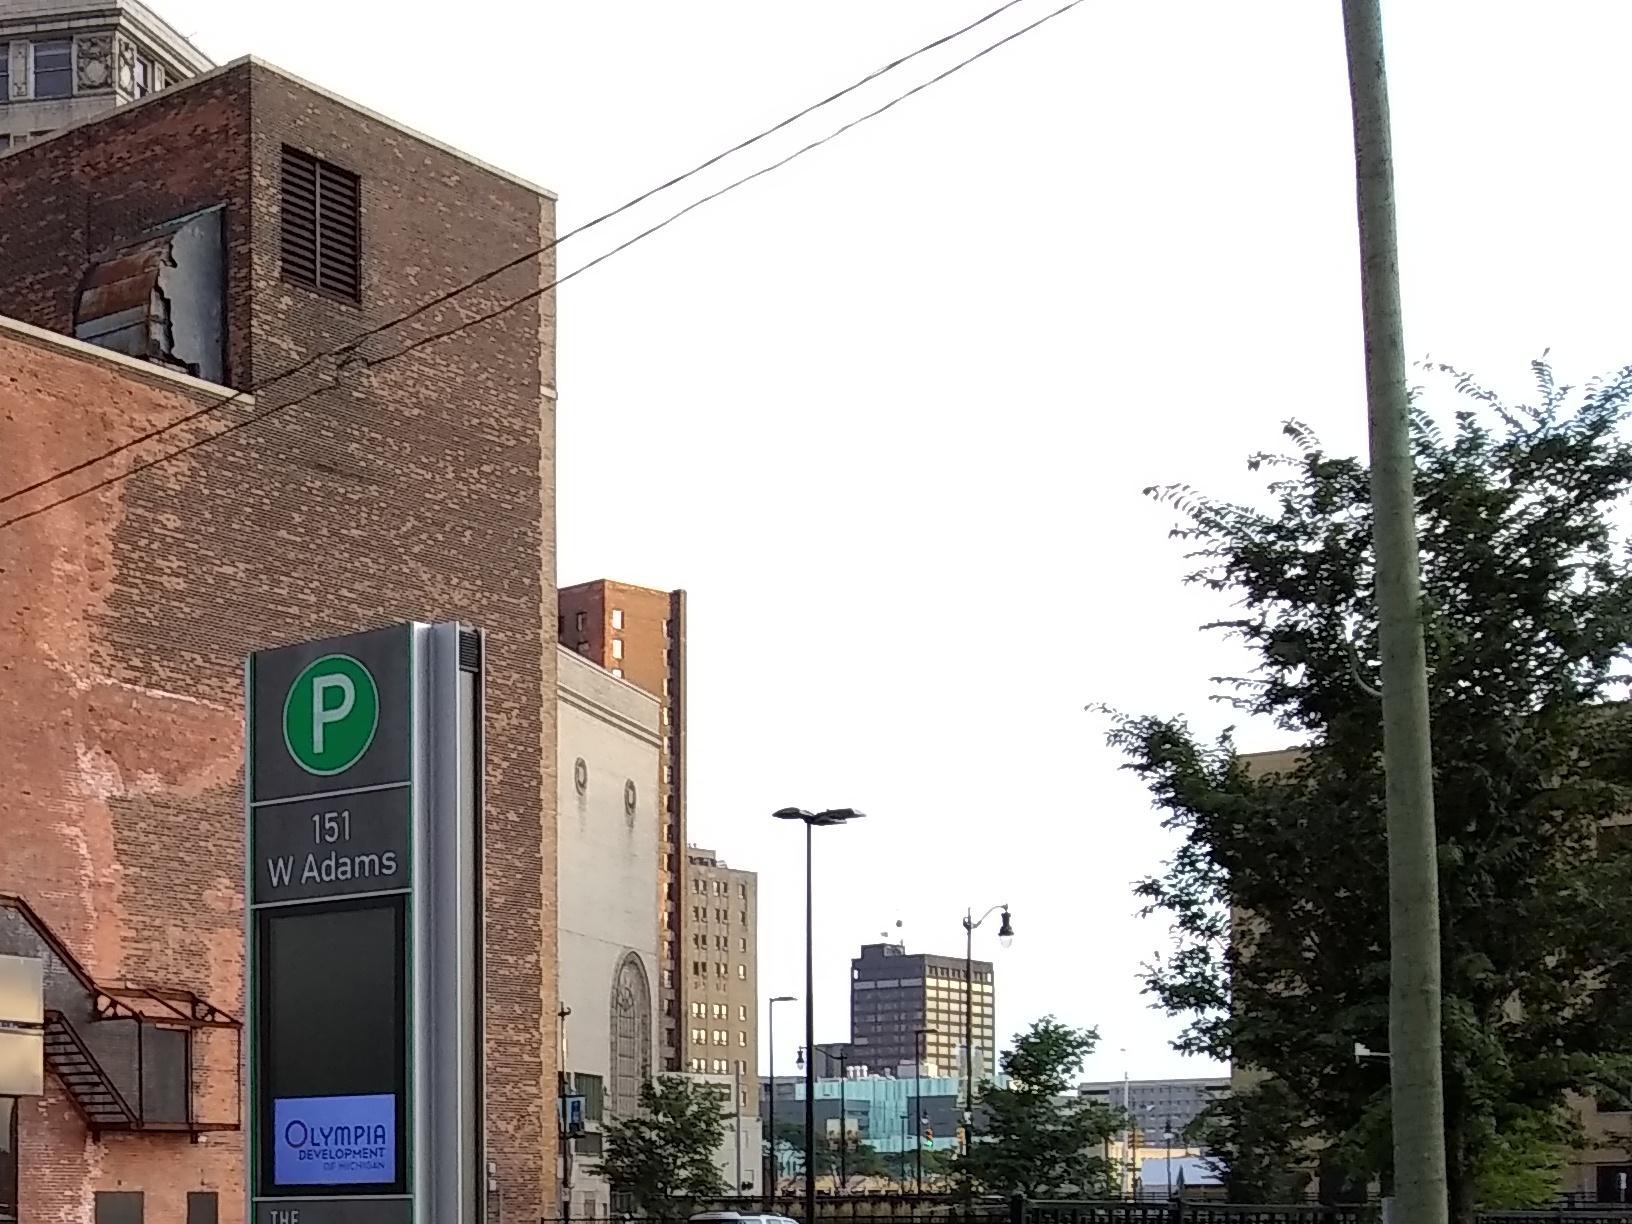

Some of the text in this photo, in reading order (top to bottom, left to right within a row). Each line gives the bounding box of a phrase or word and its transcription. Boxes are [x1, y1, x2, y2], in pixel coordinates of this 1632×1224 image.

[312, 673, 356, 754] P
[311, 809, 351, 844] 151
[268, 850, 397, 888] W Adams
[299, 1147, 386, 1161] DEVELOPMENT
